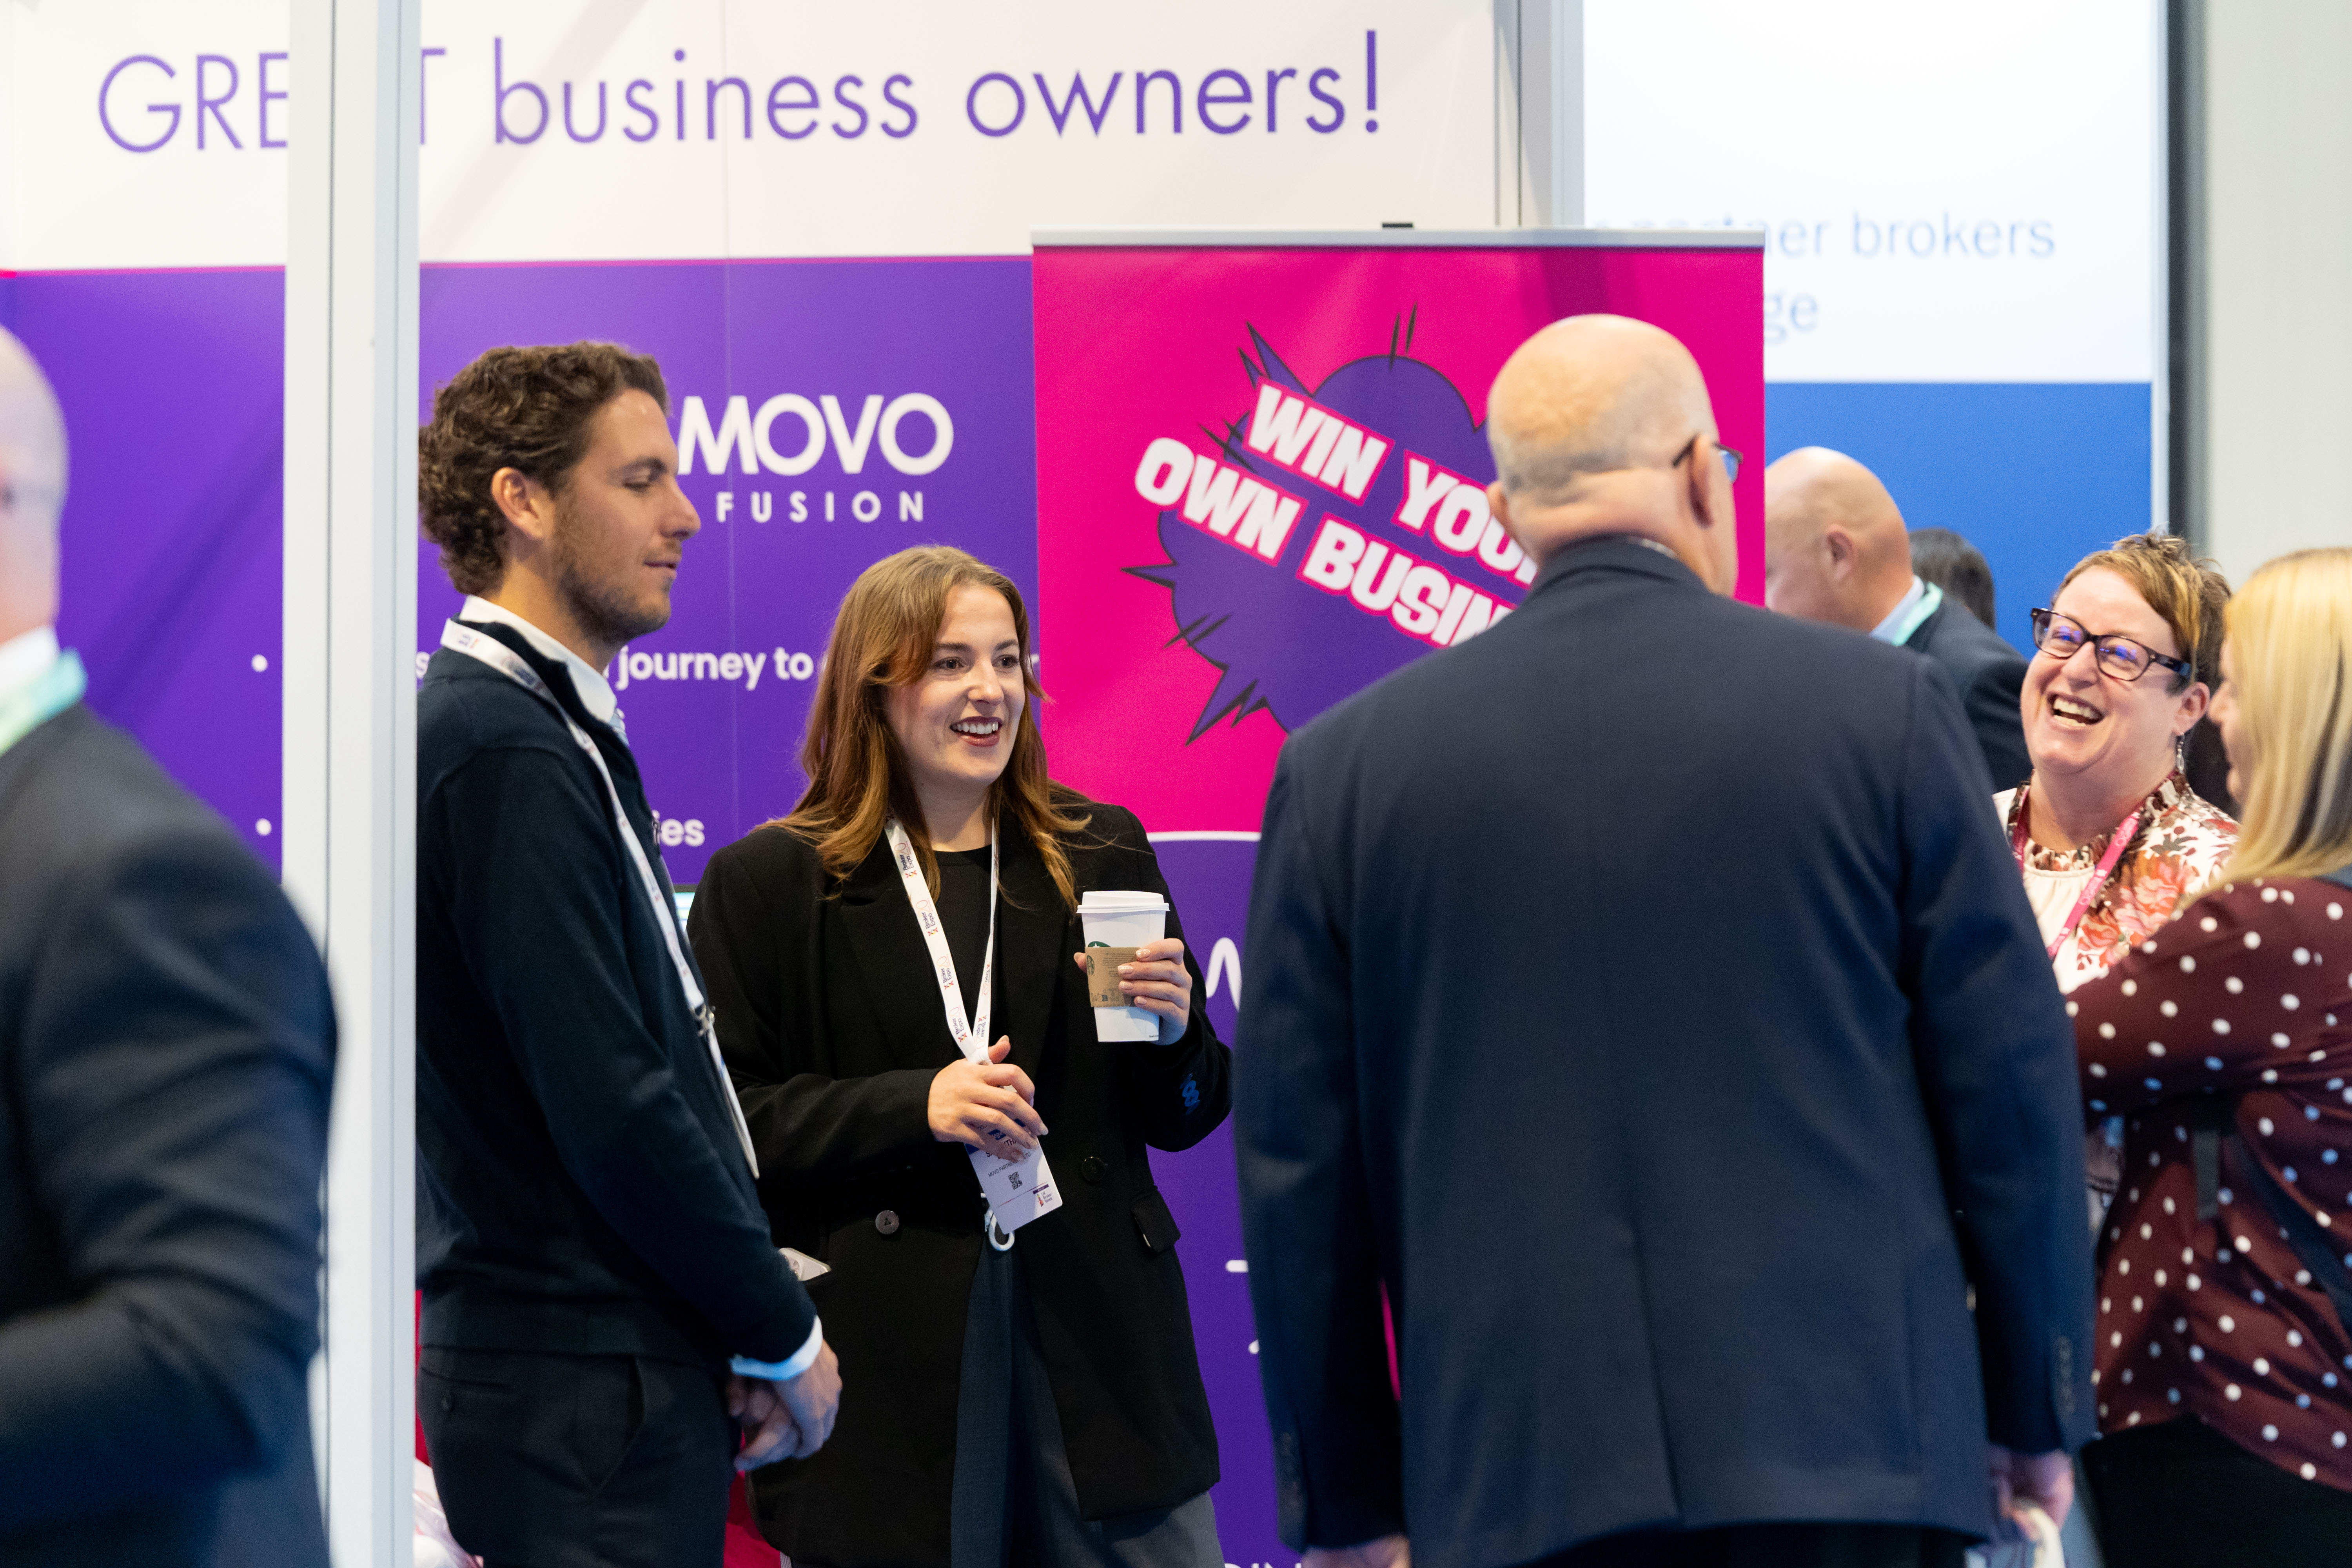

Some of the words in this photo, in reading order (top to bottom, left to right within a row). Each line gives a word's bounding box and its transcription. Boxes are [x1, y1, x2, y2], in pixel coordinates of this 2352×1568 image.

[98, 47, 446, 152] GRET
[494, 36, 918, 145] business
[966, 29, 1379, 137] owners!
[1852, 210, 2056, 259] brokers
[677, 392, 954, 476] MOVO
[1248, 384, 1387, 500] WIN
[716, 490, 924, 523] FUSION
[1134, 437, 1301, 559] OWN
[1303, 519, 1514, 647] BUSIN
[615, 645, 767, 691] journey
[774, 646, 814, 680] to
[899, 854, 909, 871] Broker
[906, 855, 915, 869] Expo
[921, 911, 931, 929] Broker
[928, 913, 936, 927] Expo
[951, 1018, 960, 1035] Broker
